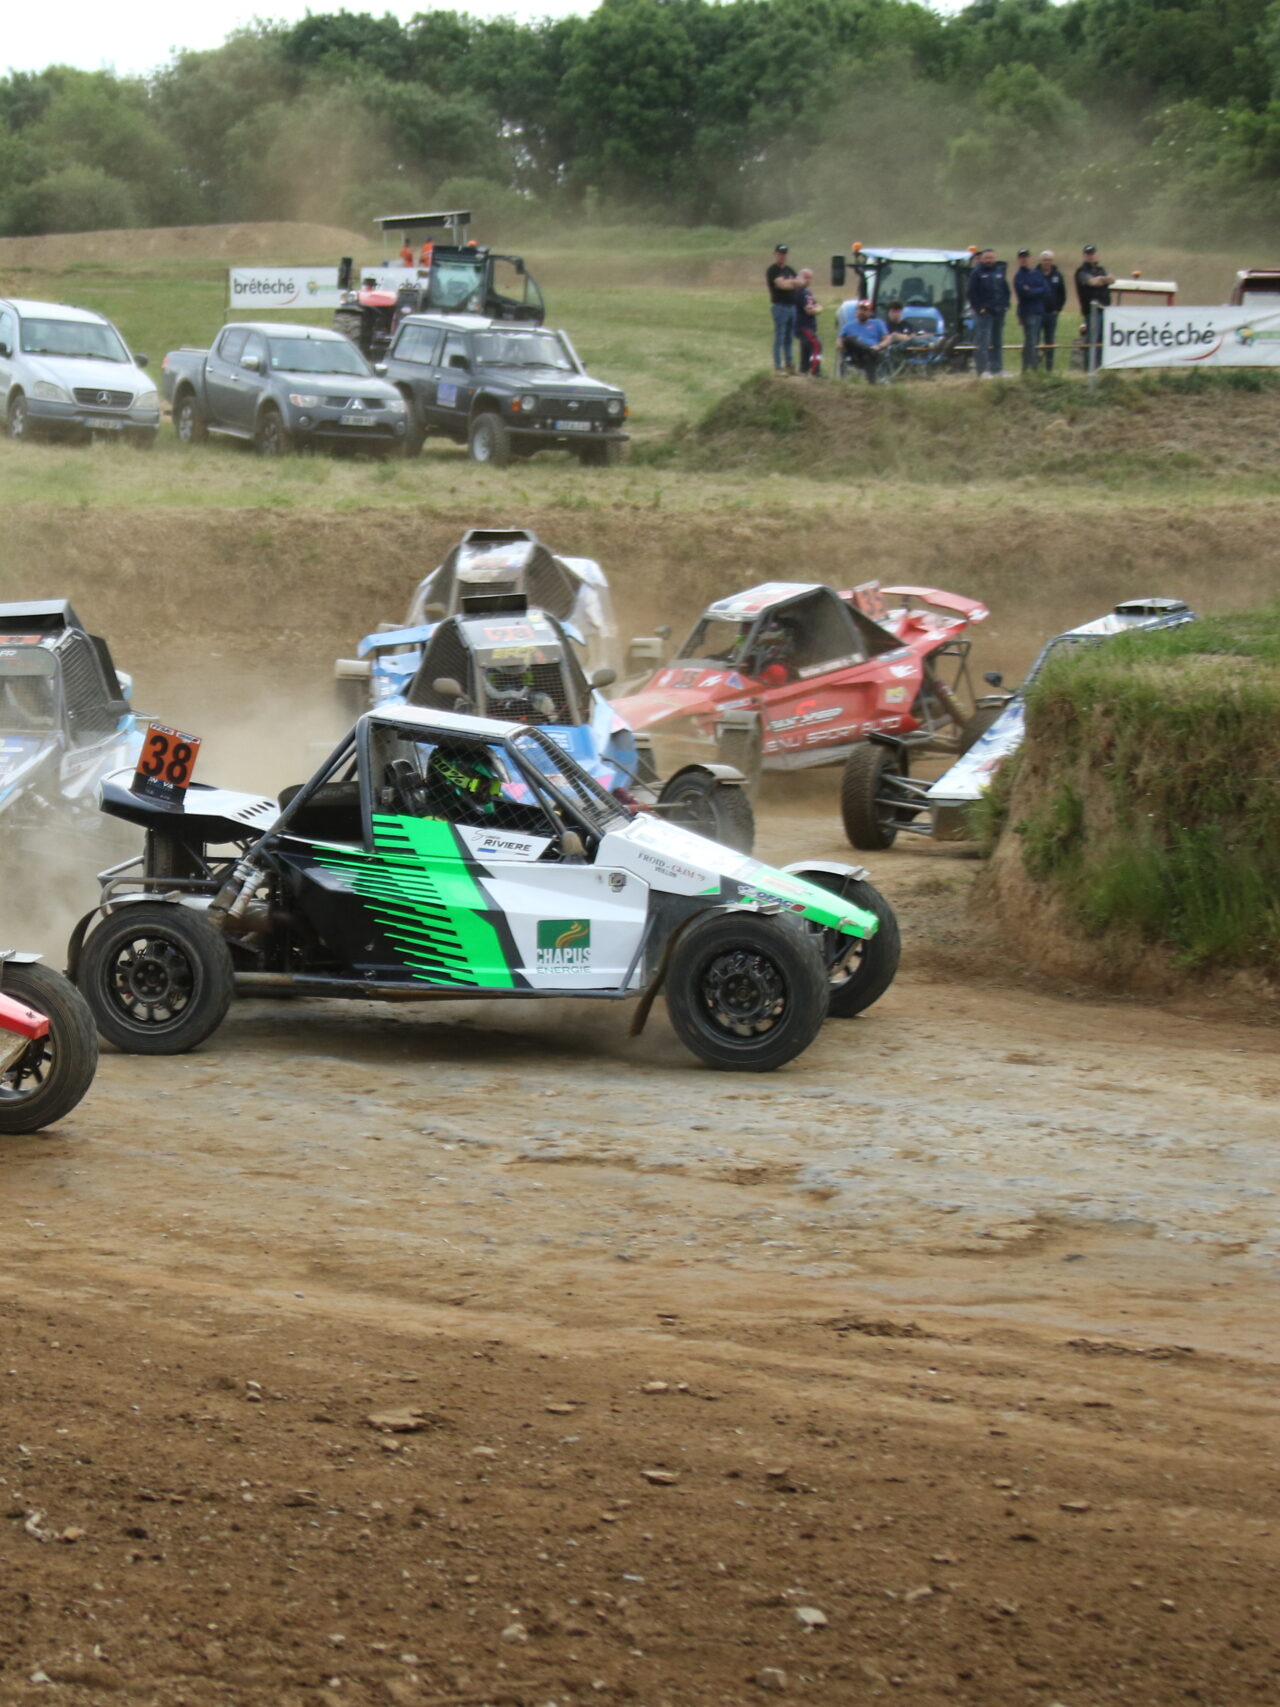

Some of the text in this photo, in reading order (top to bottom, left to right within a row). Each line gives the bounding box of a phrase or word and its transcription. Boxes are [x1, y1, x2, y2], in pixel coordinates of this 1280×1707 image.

[233, 277, 295, 295] brétéché
[1110, 322, 1215, 347] brétéché
[142, 735, 192, 785] 38
[484, 838, 533, 852] RIVIERE
[536, 947, 591, 964] CHAPUS
[536, 965, 591, 974] ENERGIE
